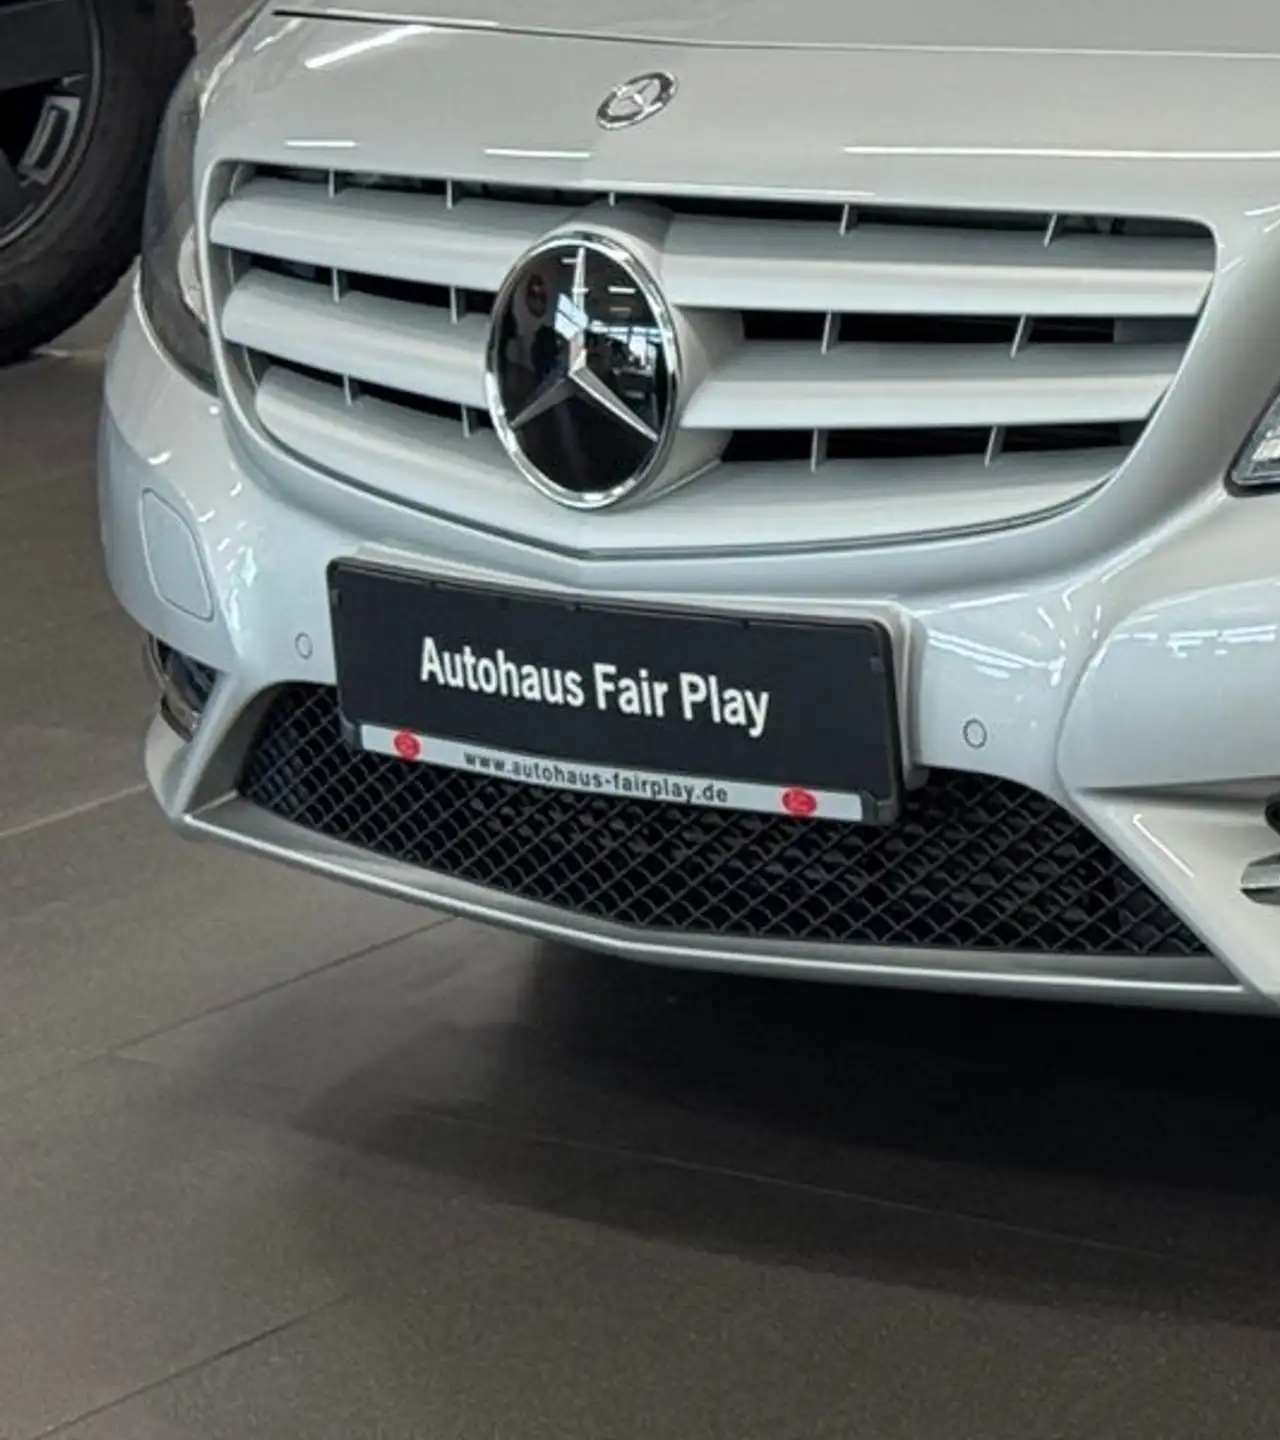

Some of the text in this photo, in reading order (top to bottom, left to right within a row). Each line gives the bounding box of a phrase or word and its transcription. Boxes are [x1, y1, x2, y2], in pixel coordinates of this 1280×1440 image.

[420, 636, 770, 738] Autohaus Fair Play
[464, 750, 729, 805] www.autohaus-fairplay.de
